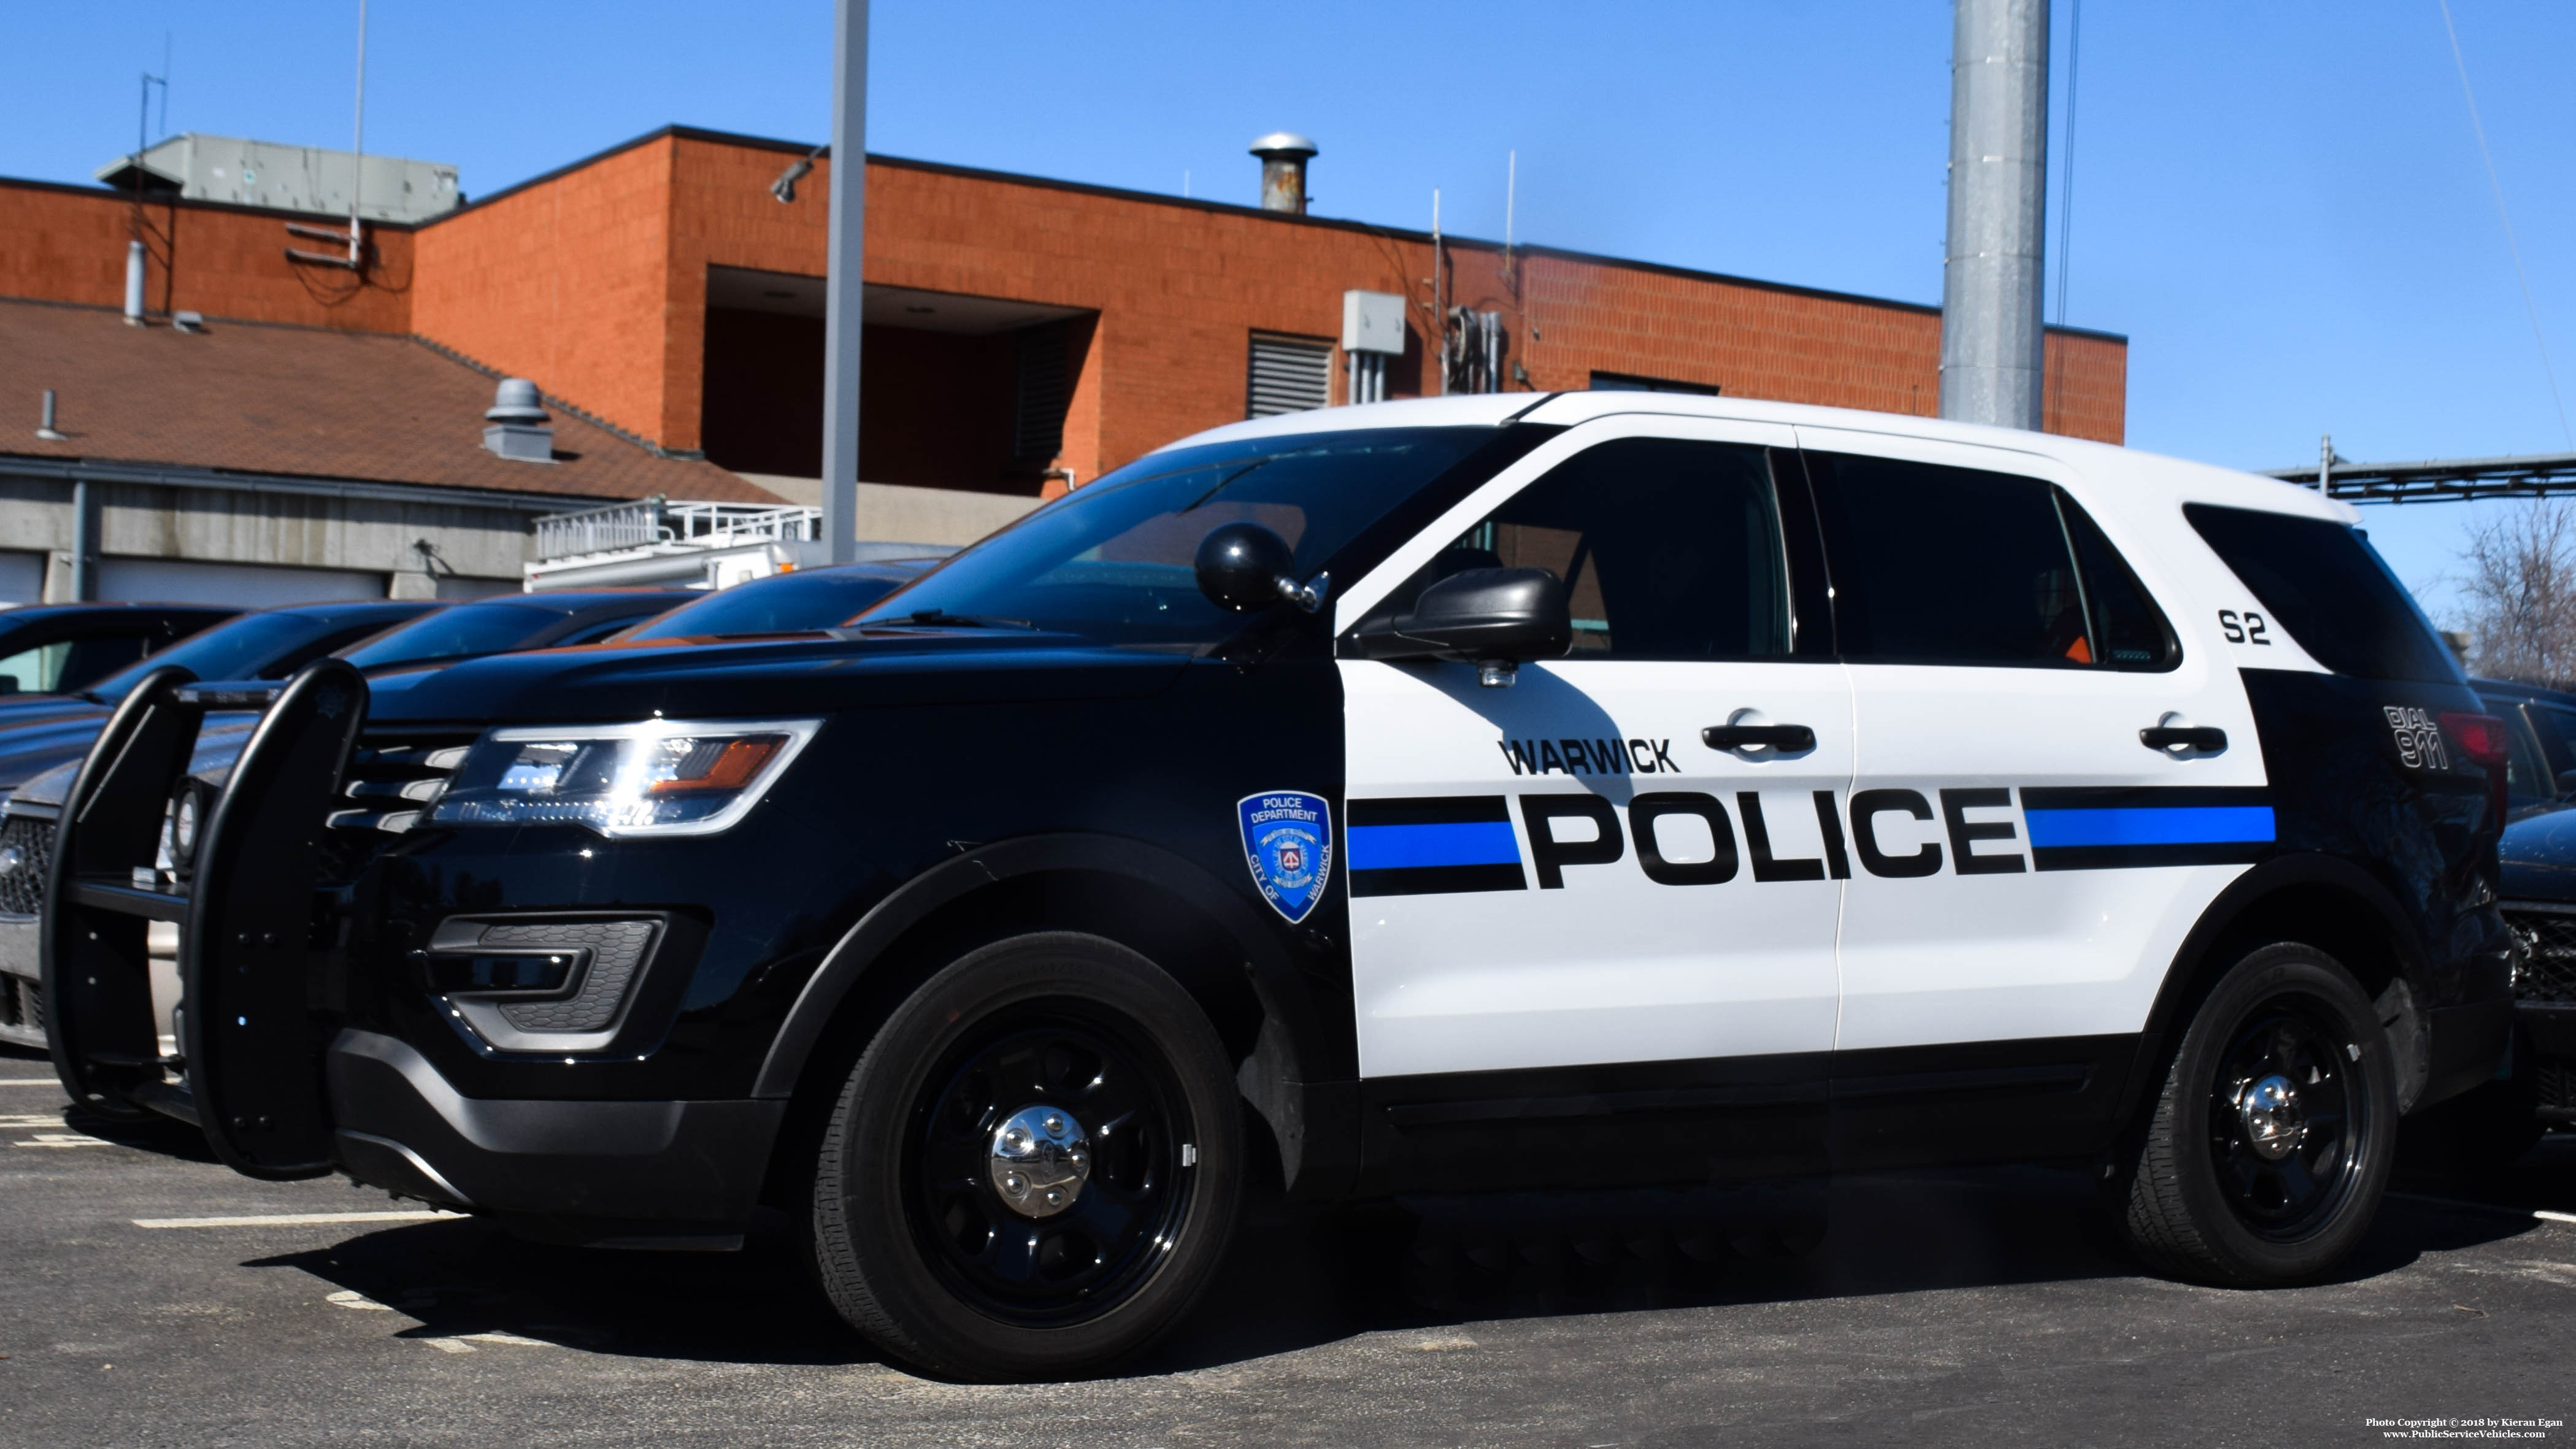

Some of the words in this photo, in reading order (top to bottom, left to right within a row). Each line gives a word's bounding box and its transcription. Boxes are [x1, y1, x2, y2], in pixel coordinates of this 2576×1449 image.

[2218, 610, 2271, 645] S2
[2383, 706, 2437, 730] DIAL
[1497, 739, 1682, 775] WARWICK
[2394, 729, 2448, 769] 911
[1251, 809, 1317, 823] DEPARTMENT
[1263, 798, 1302, 809] POLICE
[1518, 788, 2026, 889] POLICE
[1250, 854, 1267, 882] CITY
[1265, 885, 1280, 901] OF
[1307, 844, 1330, 901] WARWICK
